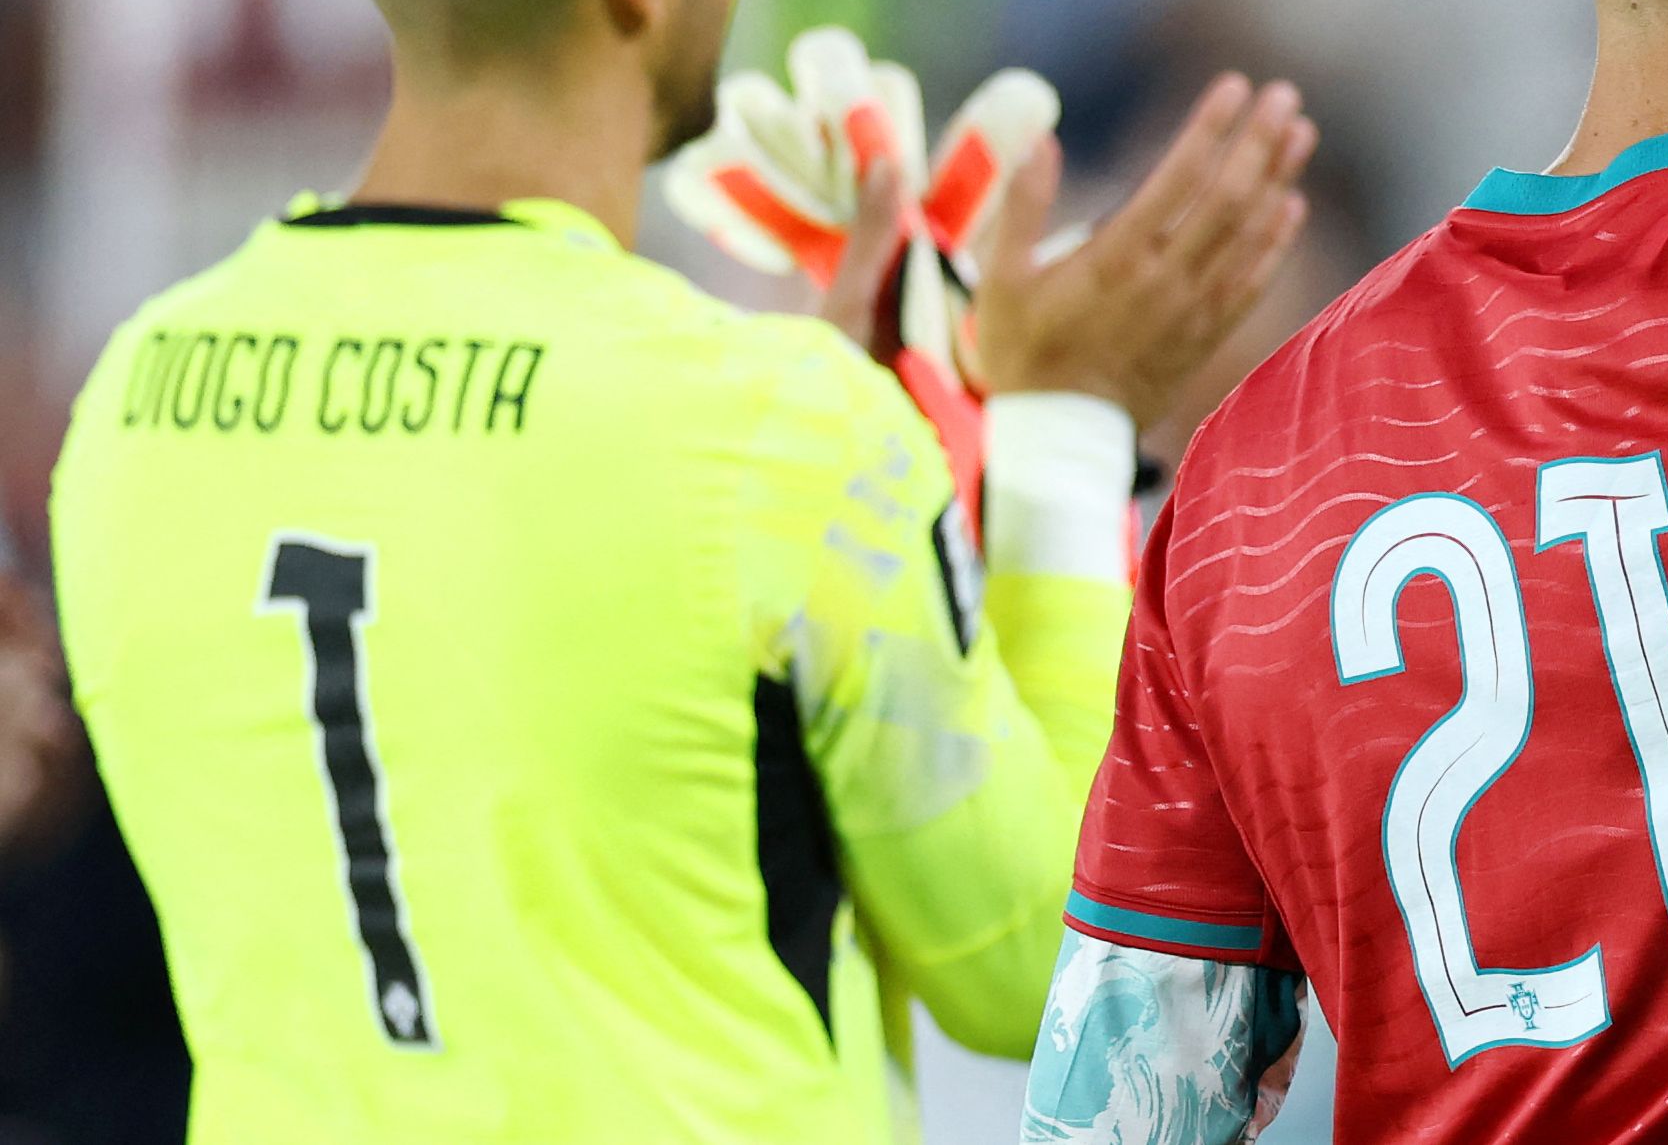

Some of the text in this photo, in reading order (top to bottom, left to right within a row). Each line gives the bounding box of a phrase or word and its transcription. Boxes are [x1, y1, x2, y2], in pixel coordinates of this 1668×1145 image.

[122, 332, 545, 435] DIOGO COSTA
[257, 532, 441, 1051] 1
